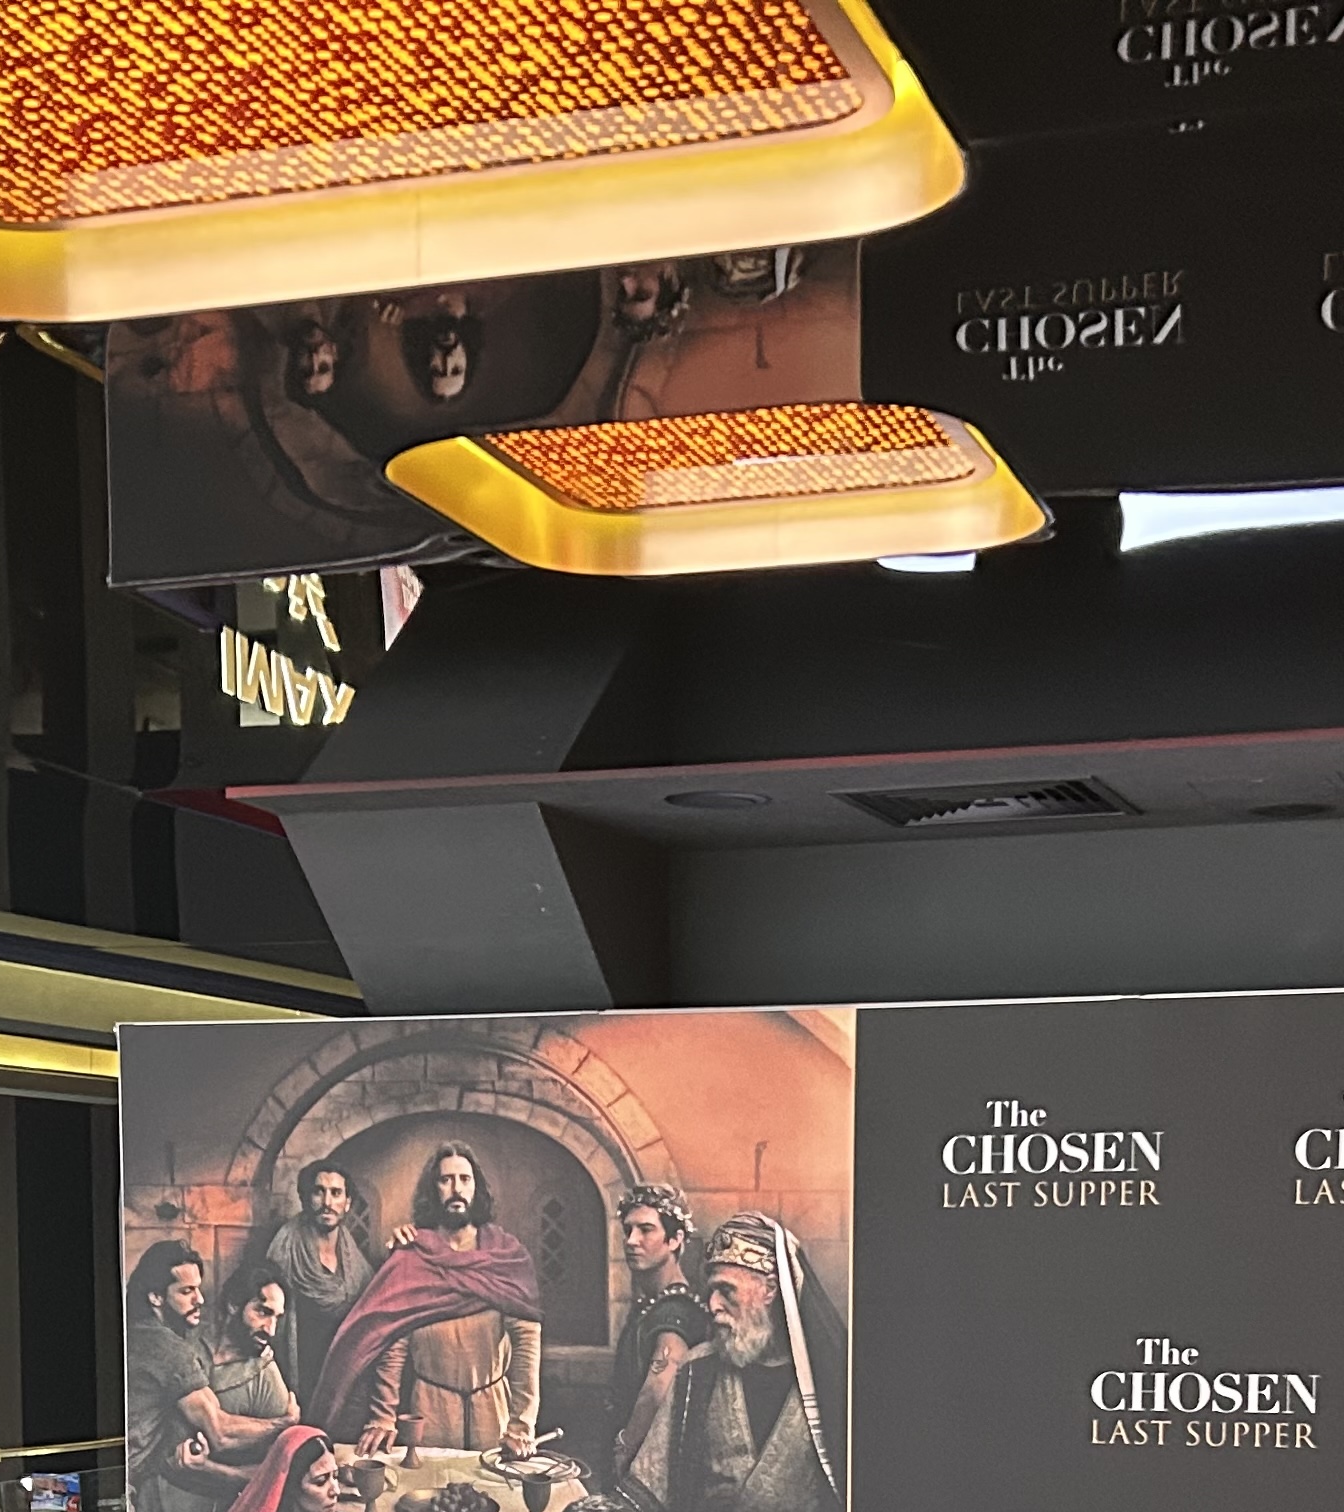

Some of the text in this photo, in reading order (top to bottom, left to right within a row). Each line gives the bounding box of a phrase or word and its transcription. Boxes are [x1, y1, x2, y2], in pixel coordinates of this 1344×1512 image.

[987, 1100, 1046, 1127] The
[943, 1132, 1164, 1174] CHOSEN
[943, 1180, 1159, 1207] LAST SUPPER
[1137, 1339, 1198, 1365] The
[1091, 1371, 1320, 1413] CHOSEN
[1092, 1420, 1316, 1448] LAST SUPPER
